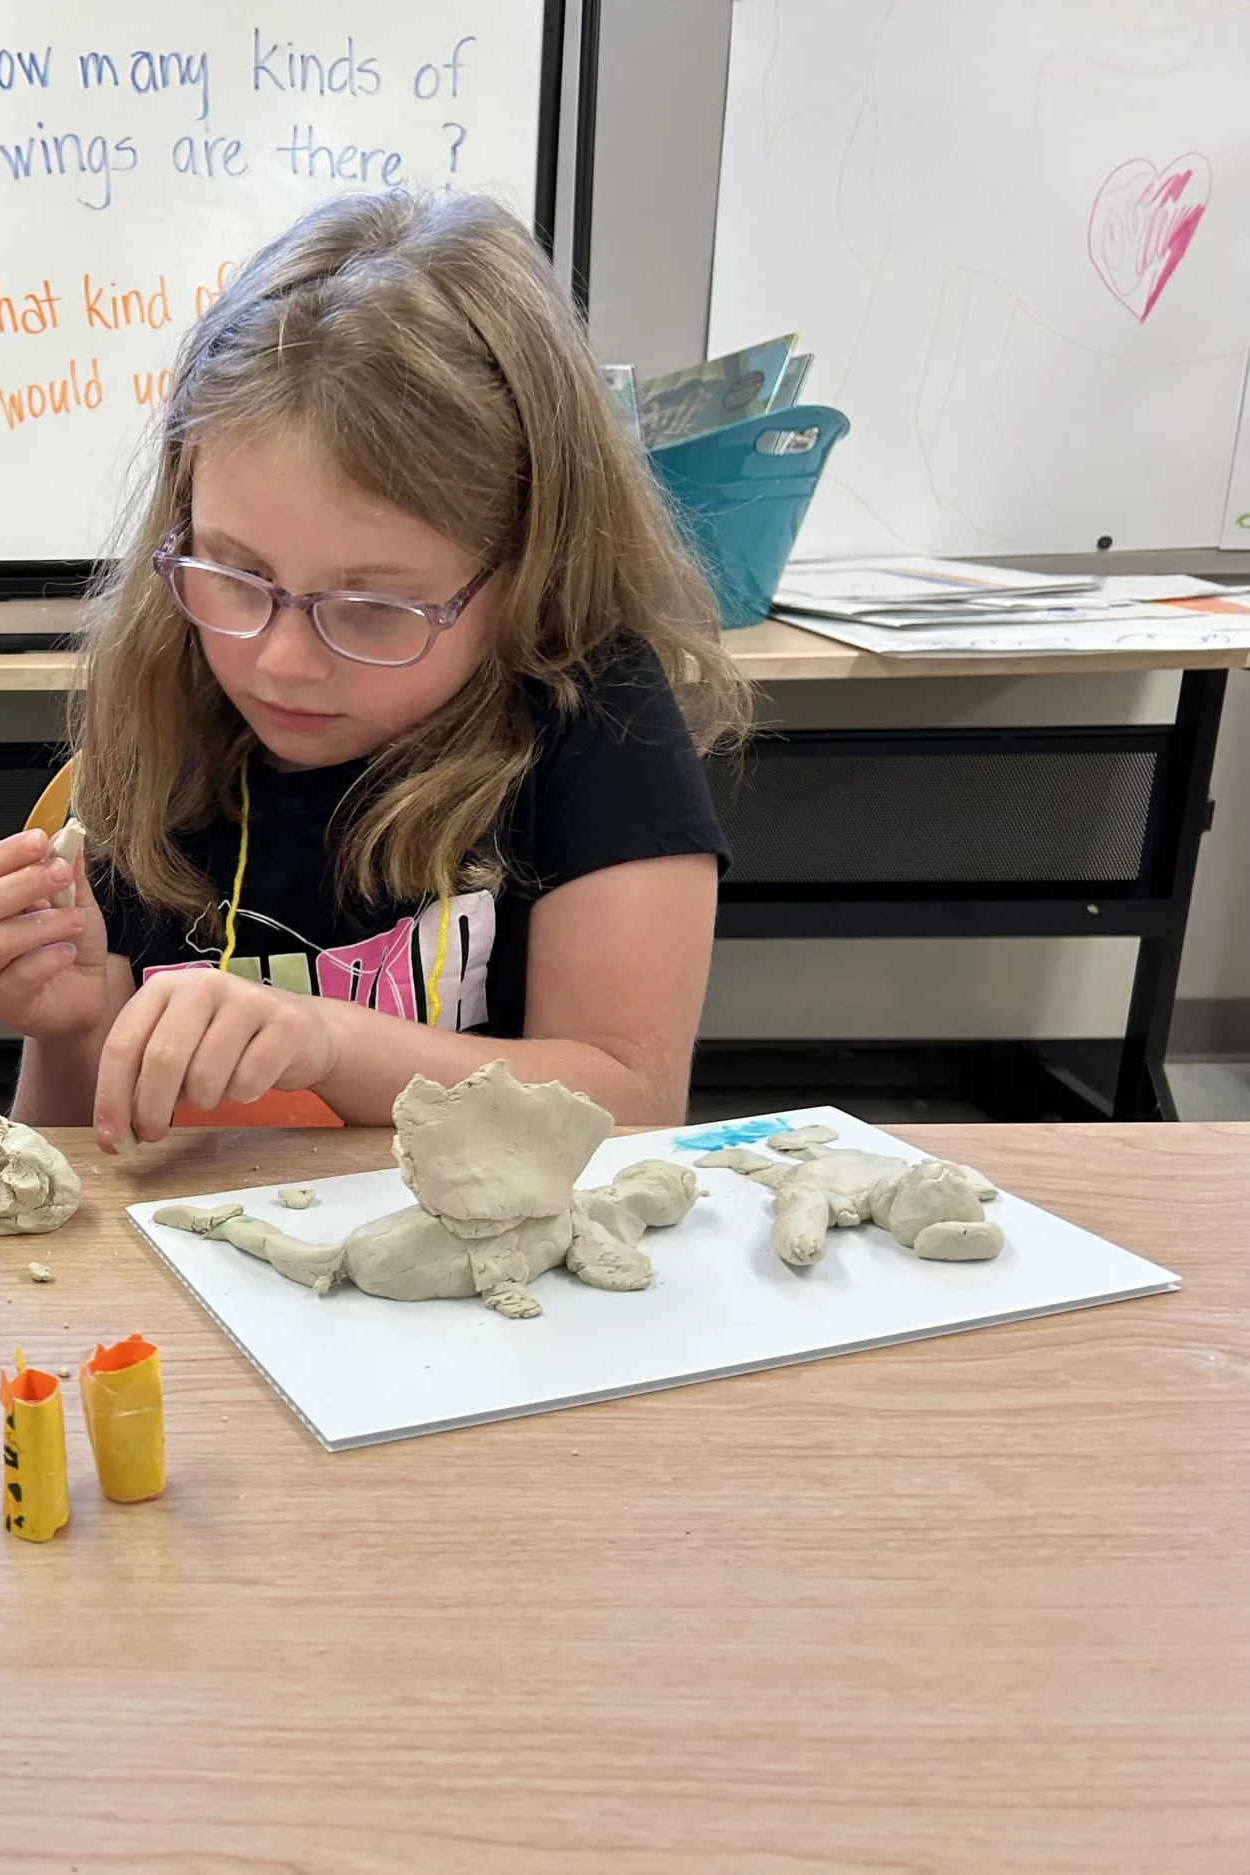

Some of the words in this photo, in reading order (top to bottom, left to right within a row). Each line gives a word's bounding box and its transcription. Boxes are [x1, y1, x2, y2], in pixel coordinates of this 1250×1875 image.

[80, 45, 209, 121] many
[252, 27, 381, 97] kinds
[413, 36, 477, 99] of
[172, 134, 248, 178] are
[83, 274, 172, 331] kind
